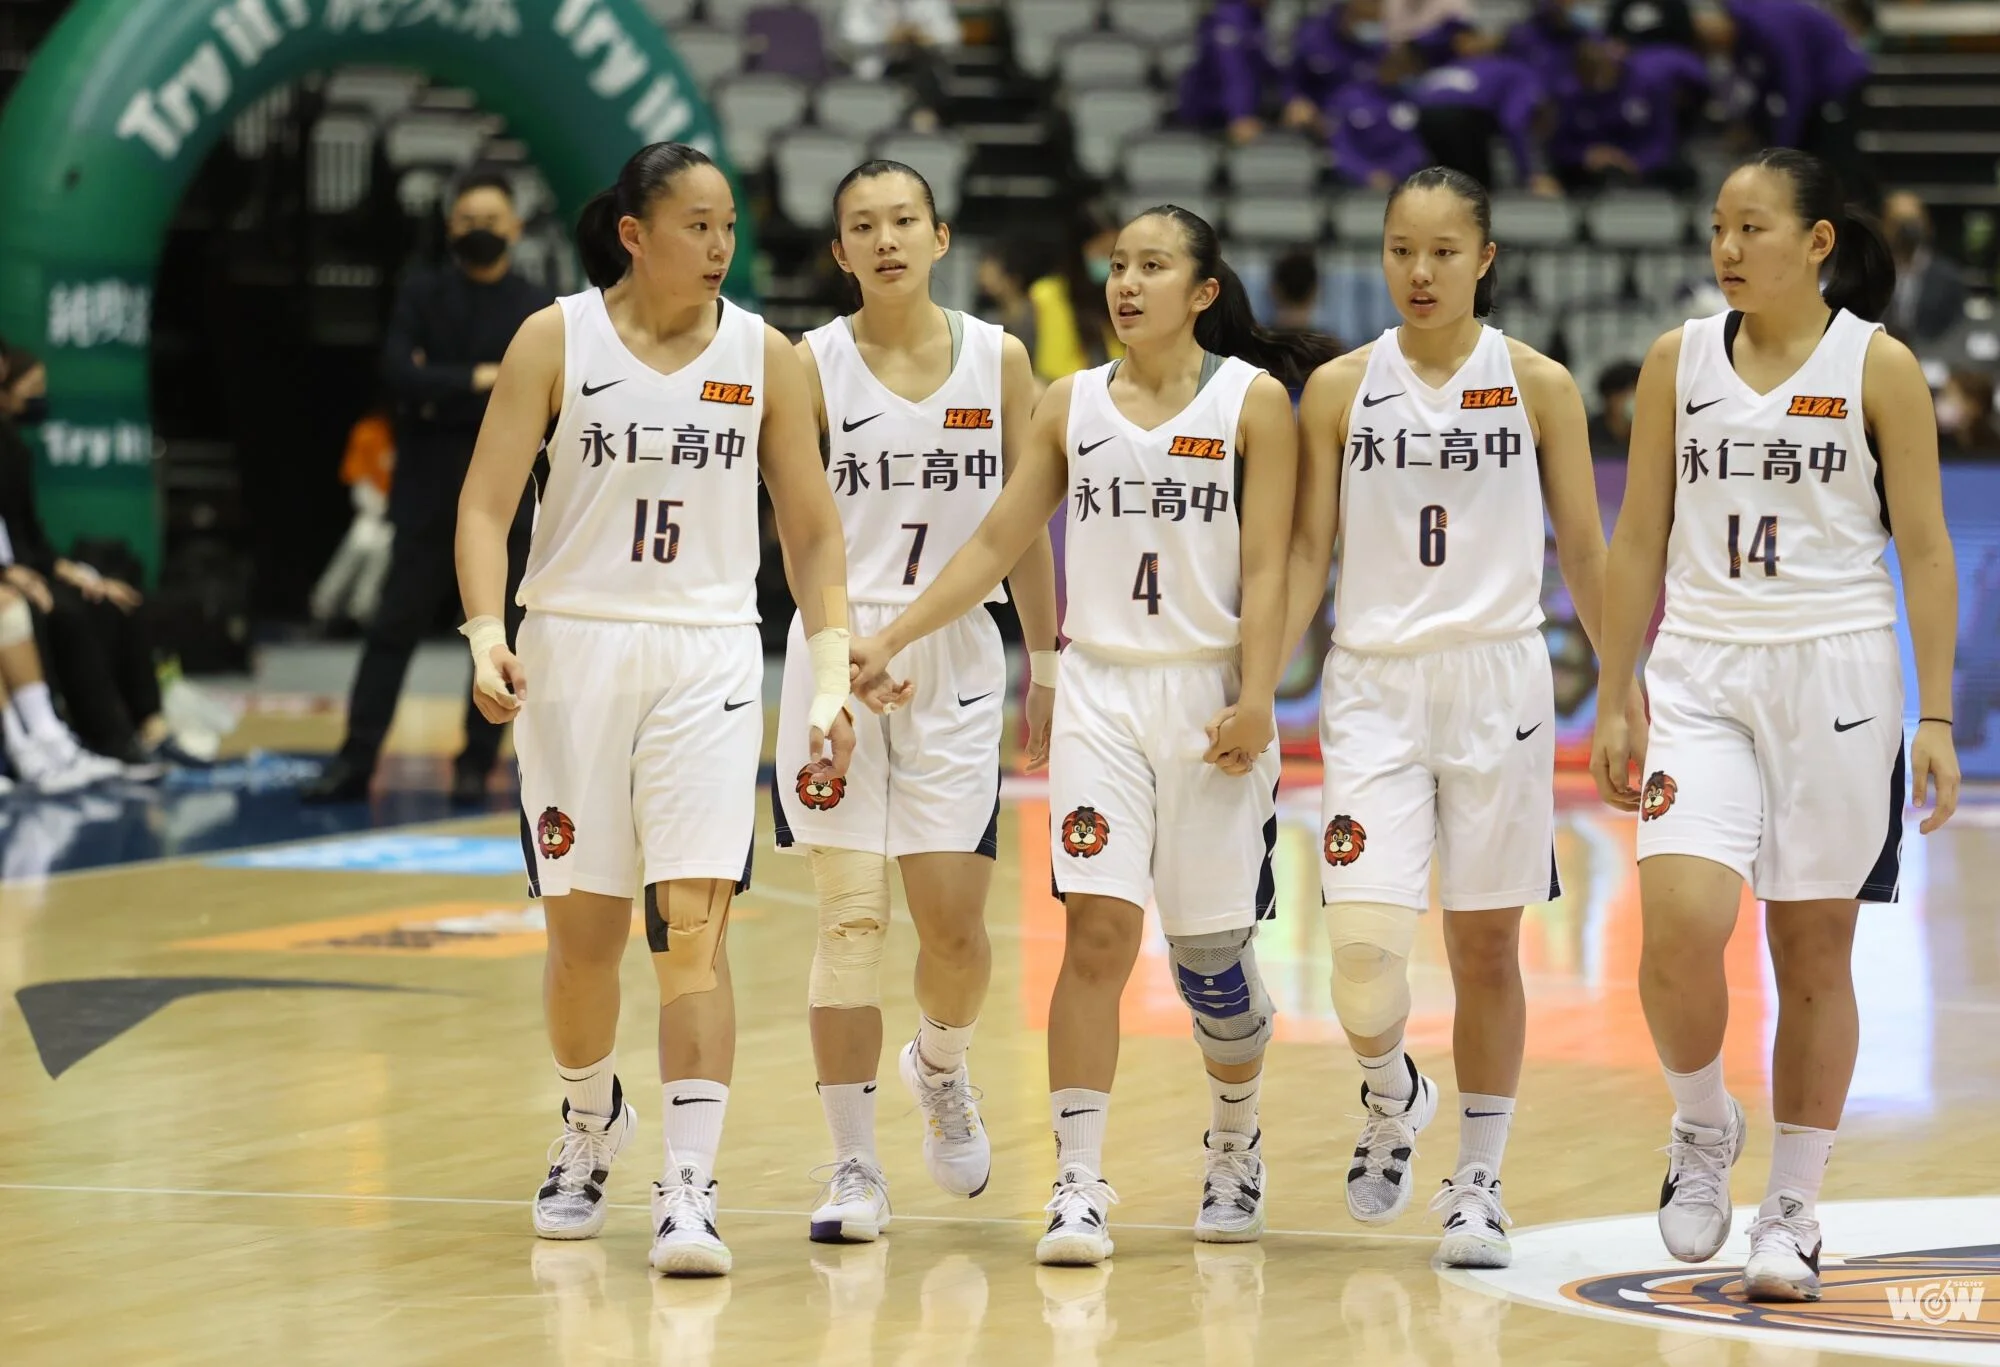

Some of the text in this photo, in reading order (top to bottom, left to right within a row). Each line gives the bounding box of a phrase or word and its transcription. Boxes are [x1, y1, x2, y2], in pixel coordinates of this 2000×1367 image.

[115, 42, 232, 161] Try
[579, 422, 746, 470] 永仁高中
[833, 448, 997, 496] 永仁高中
[1349, 427, 1521, 471] 永仁高中
[1681, 438, 1847, 484] 永仁高中
[1074, 477, 1229, 522] 永仁高中
[630, 498, 684, 564] 15
[901, 523, 929, 585] 7
[1419, 504, 1448, 567] 6
[1728, 514, 1780, 579] 14
[1132, 552, 1162, 615] 4
